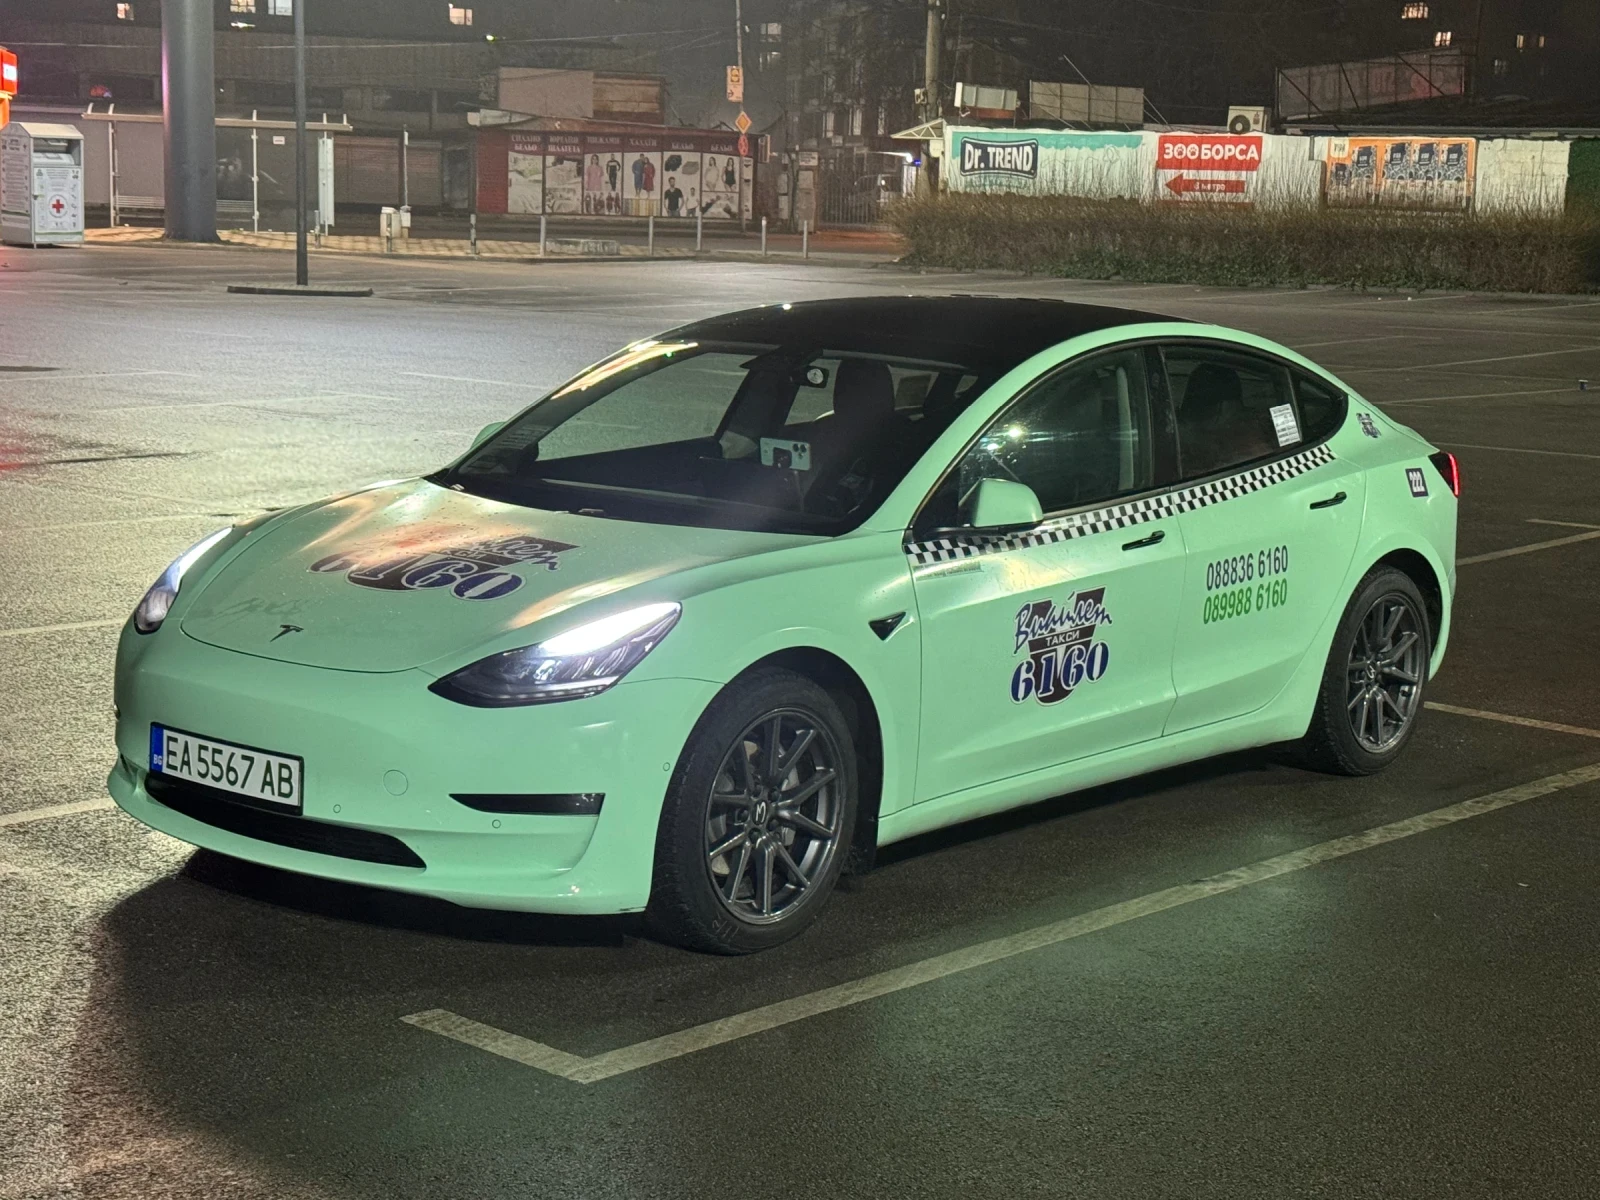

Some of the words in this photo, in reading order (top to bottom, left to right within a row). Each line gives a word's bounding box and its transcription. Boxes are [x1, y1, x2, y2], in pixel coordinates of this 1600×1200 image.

[514, 143, 538, 152] БЕЛЬО
[964, 142, 985, 171] Dr.
[987, 145, 1034, 172] TREND
[1163, 142, 1260, 161] ЗООБОРСА
[1206, 552, 1254, 592] 088836
[1258, 544, 1288, 579] 6160
[1203, 586, 1253, 625] 089988
[1256, 578, 1287, 612] 6160
[1045, 629, 1080, 647] ТАКСИ
[1010, 641, 1110, 703] 6160
[153, 753, 163, 766] BG
